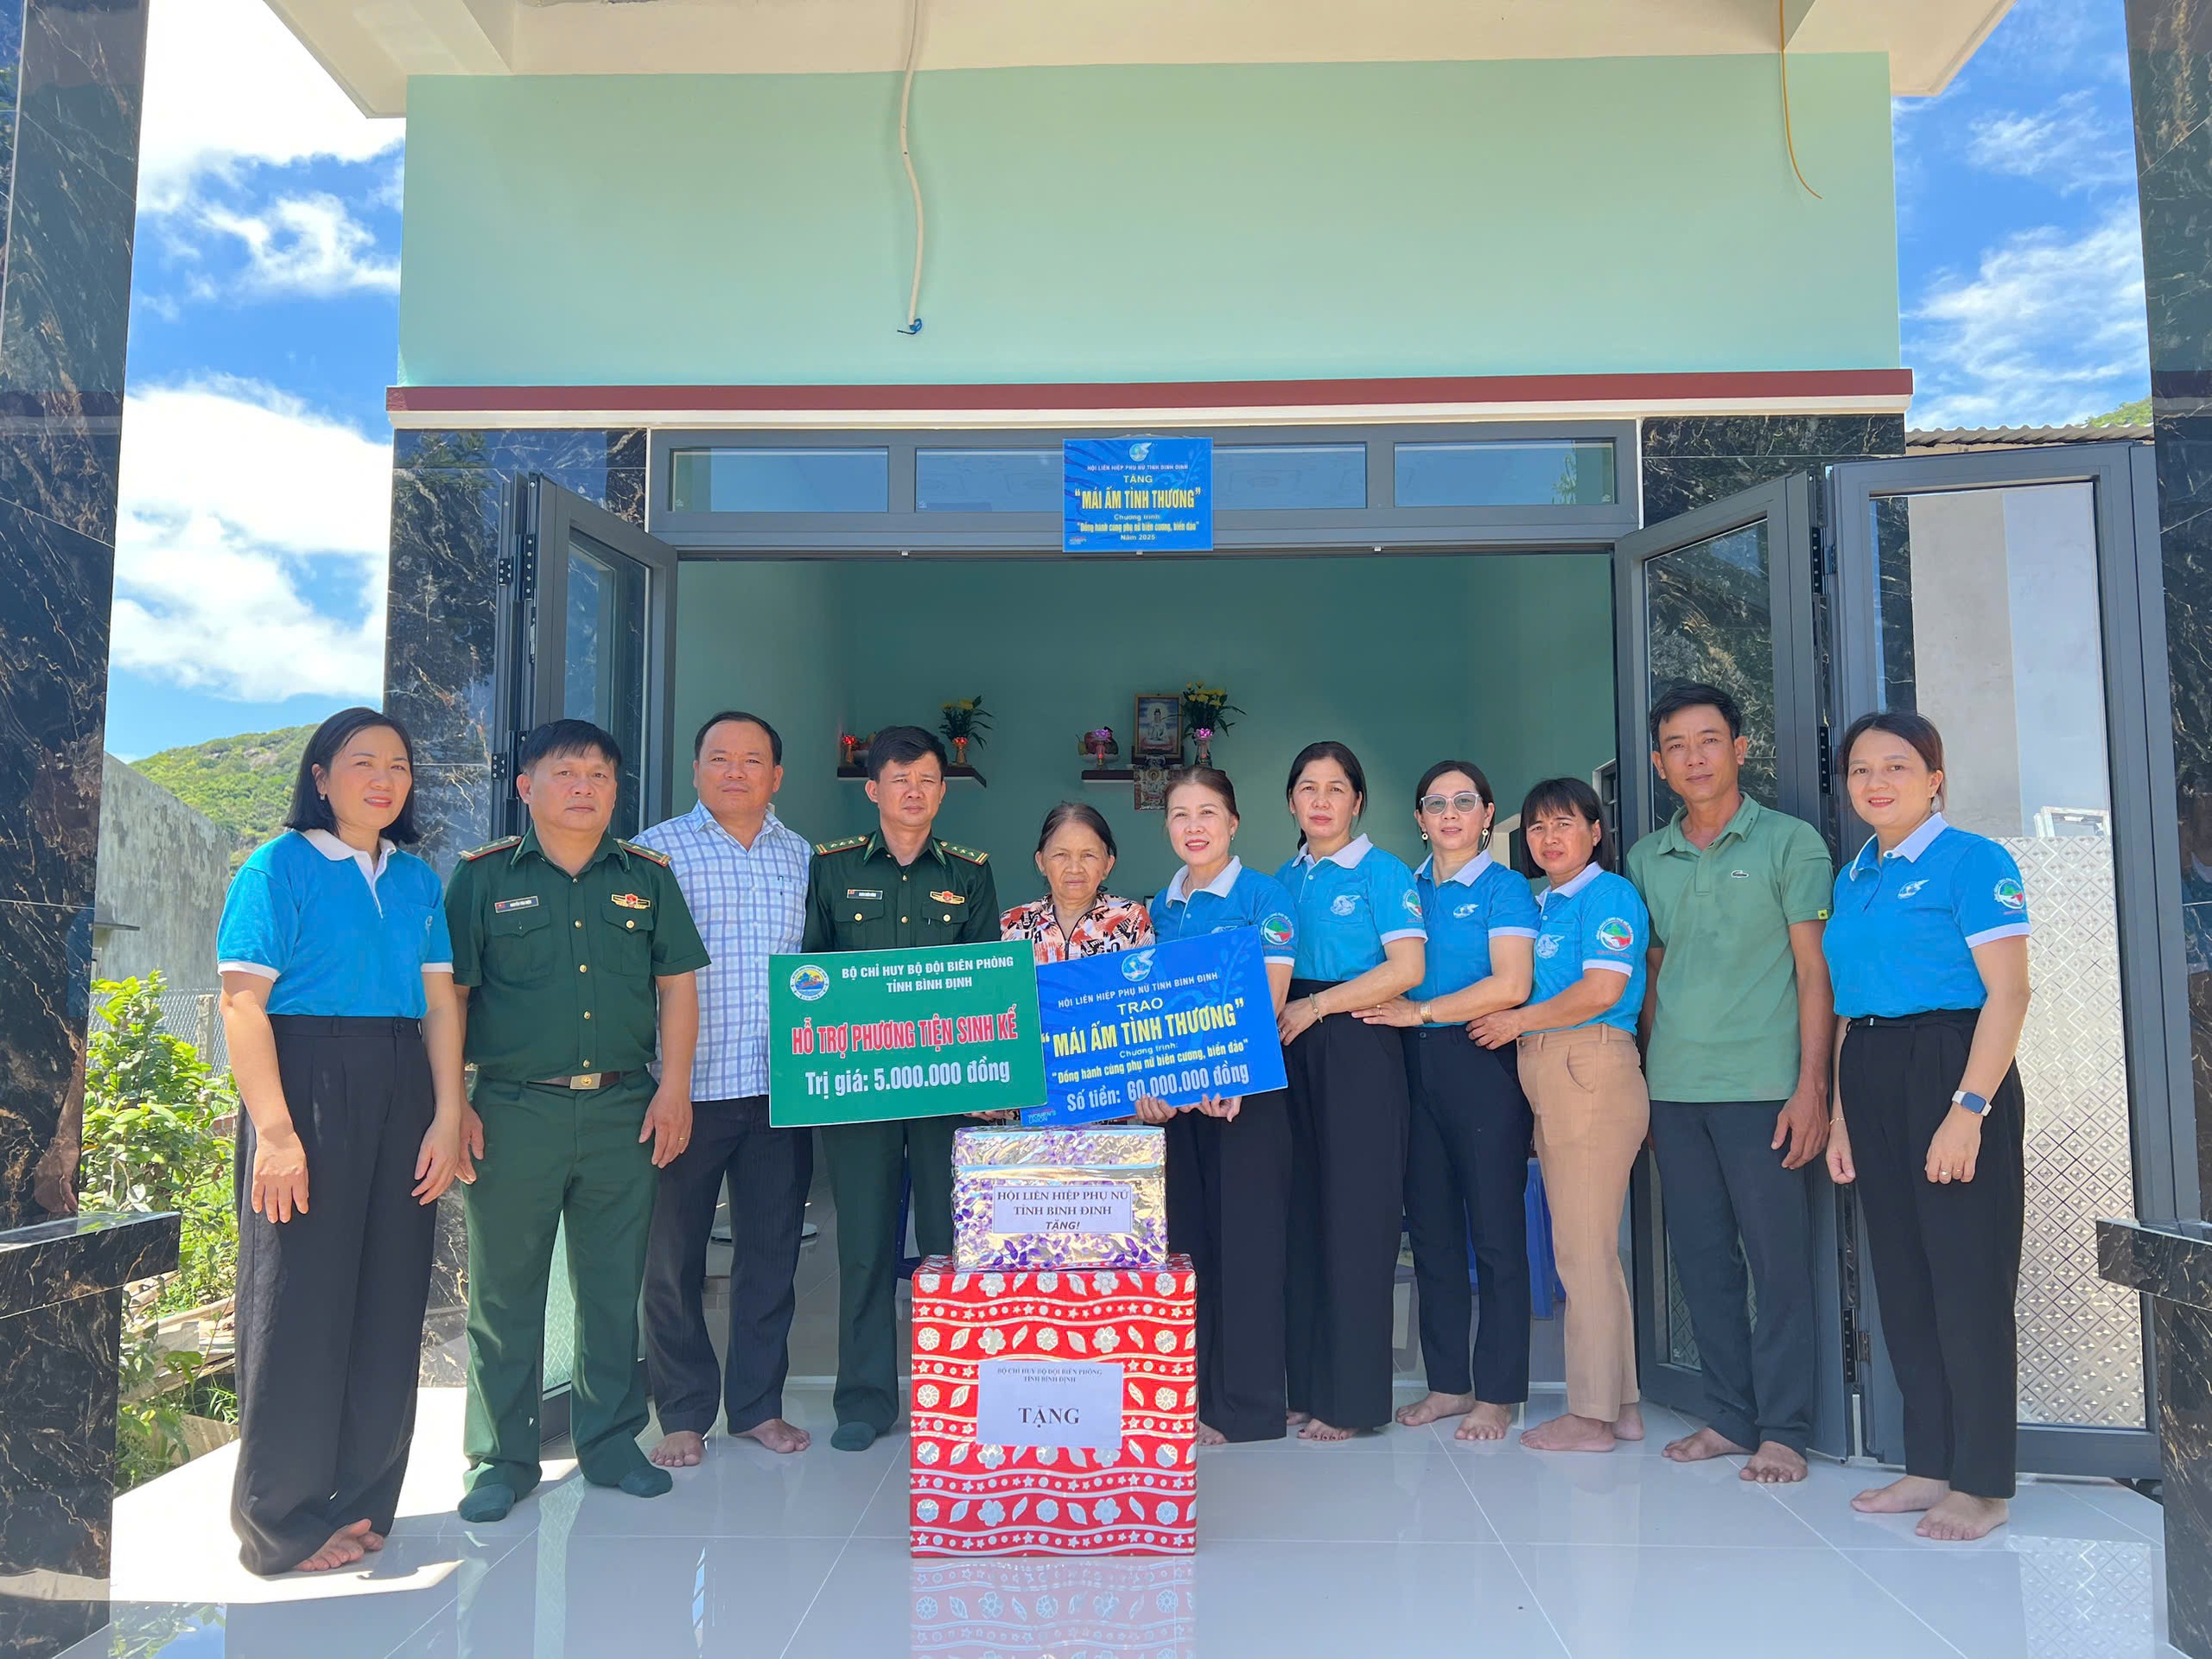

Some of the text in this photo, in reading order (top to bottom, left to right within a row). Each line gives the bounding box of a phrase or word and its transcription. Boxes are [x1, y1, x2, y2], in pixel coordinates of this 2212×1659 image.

[1123, 474, 1153, 485] TẶNG
[1104, 486, 1122, 509] ẤM
[1124, 486, 1149, 509] TÌNH
[842, 956, 1014, 980] BỘ CHỈ HUY BỘ ĐỘI BIÊN PHÒNG
[887, 976, 972, 993] TỈNH BÌNH ĐỊNH
[1058, 972, 1218, 1008] HỘI LIÊN HIỆP PHỤ NỮ TỈNH BÌNH ĐỊNH
[1116, 997, 1164, 1015] TRAO
[791, 1004, 1018, 1058] HỖ TRỢ PHƯƠNG TIỆN SINH KẾ
[1091, 1020, 1117, 1051] ẤM
[1121, 1016, 1163, 1046] TÌNH
[1081, 1065, 1102, 1080] hành
[1104, 1063, 1125, 1076] cùng
[1127, 1059, 1142, 1073] phụ
[1144, 1055, 1155, 1069] nữ
[1156, 1053, 1175, 1066] biên
[1207, 1041, 1226, 1058] biển
[1119, 1047, 1154, 1058] Chương
[805, 1056, 1010, 1099] Trị giá: 5.000.000 đồng
[1067, 1060, 1249, 1112] Số tiền: 60.000.000 đồng
[997, 1190, 1020, 1202] HỘI
[1023, 1190, 1049, 1200] LIÊN
[1052, 1190, 1079, 1202] HIỆP
[1083, 1192, 1108, 1202] PHỤ
[1014, 1205, 1111, 1217] TỈNH BÌNH ĐỊNH
[1046, 1219, 1080, 1232] TẶNG!
[1018, 1405, 1079, 1428] TẶNG
